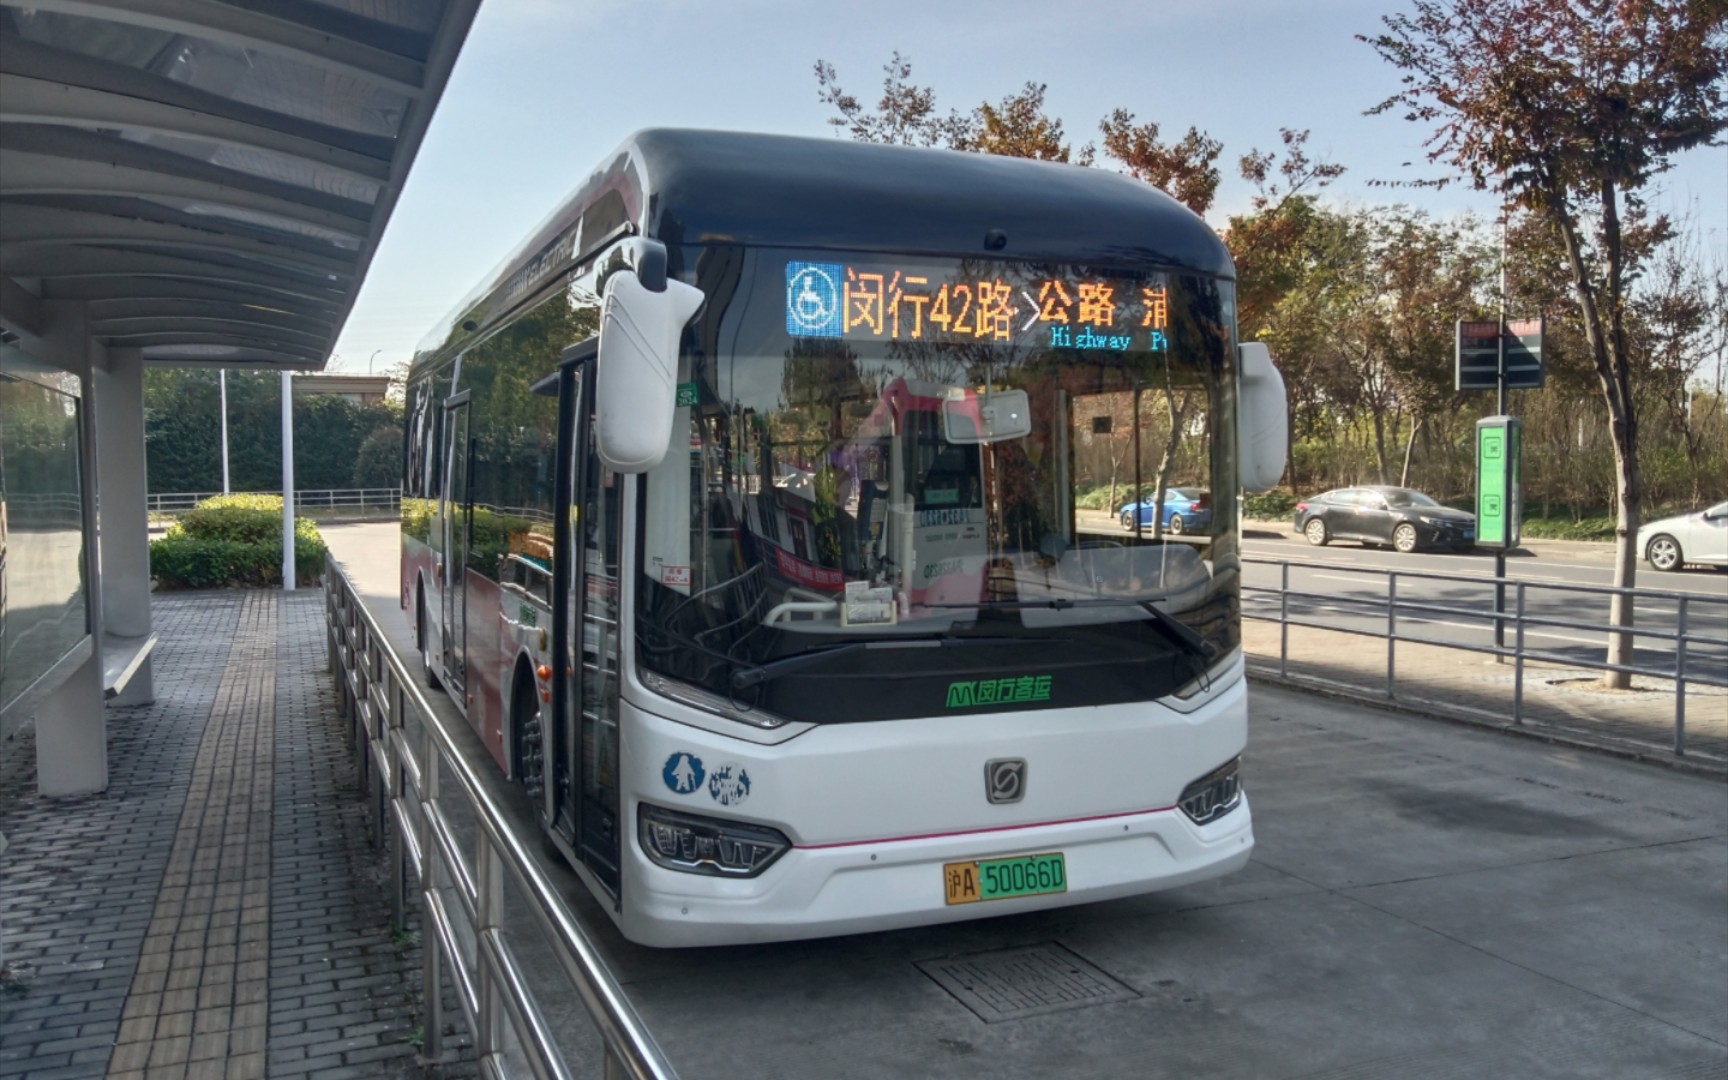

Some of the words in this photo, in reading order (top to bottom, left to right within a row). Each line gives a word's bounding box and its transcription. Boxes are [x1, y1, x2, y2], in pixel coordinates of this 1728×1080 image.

[843, 267, 1019, 342] 闵行42路
[1039, 280, 1115, 327] 公路
[1050, 325, 1132, 351] Highway
